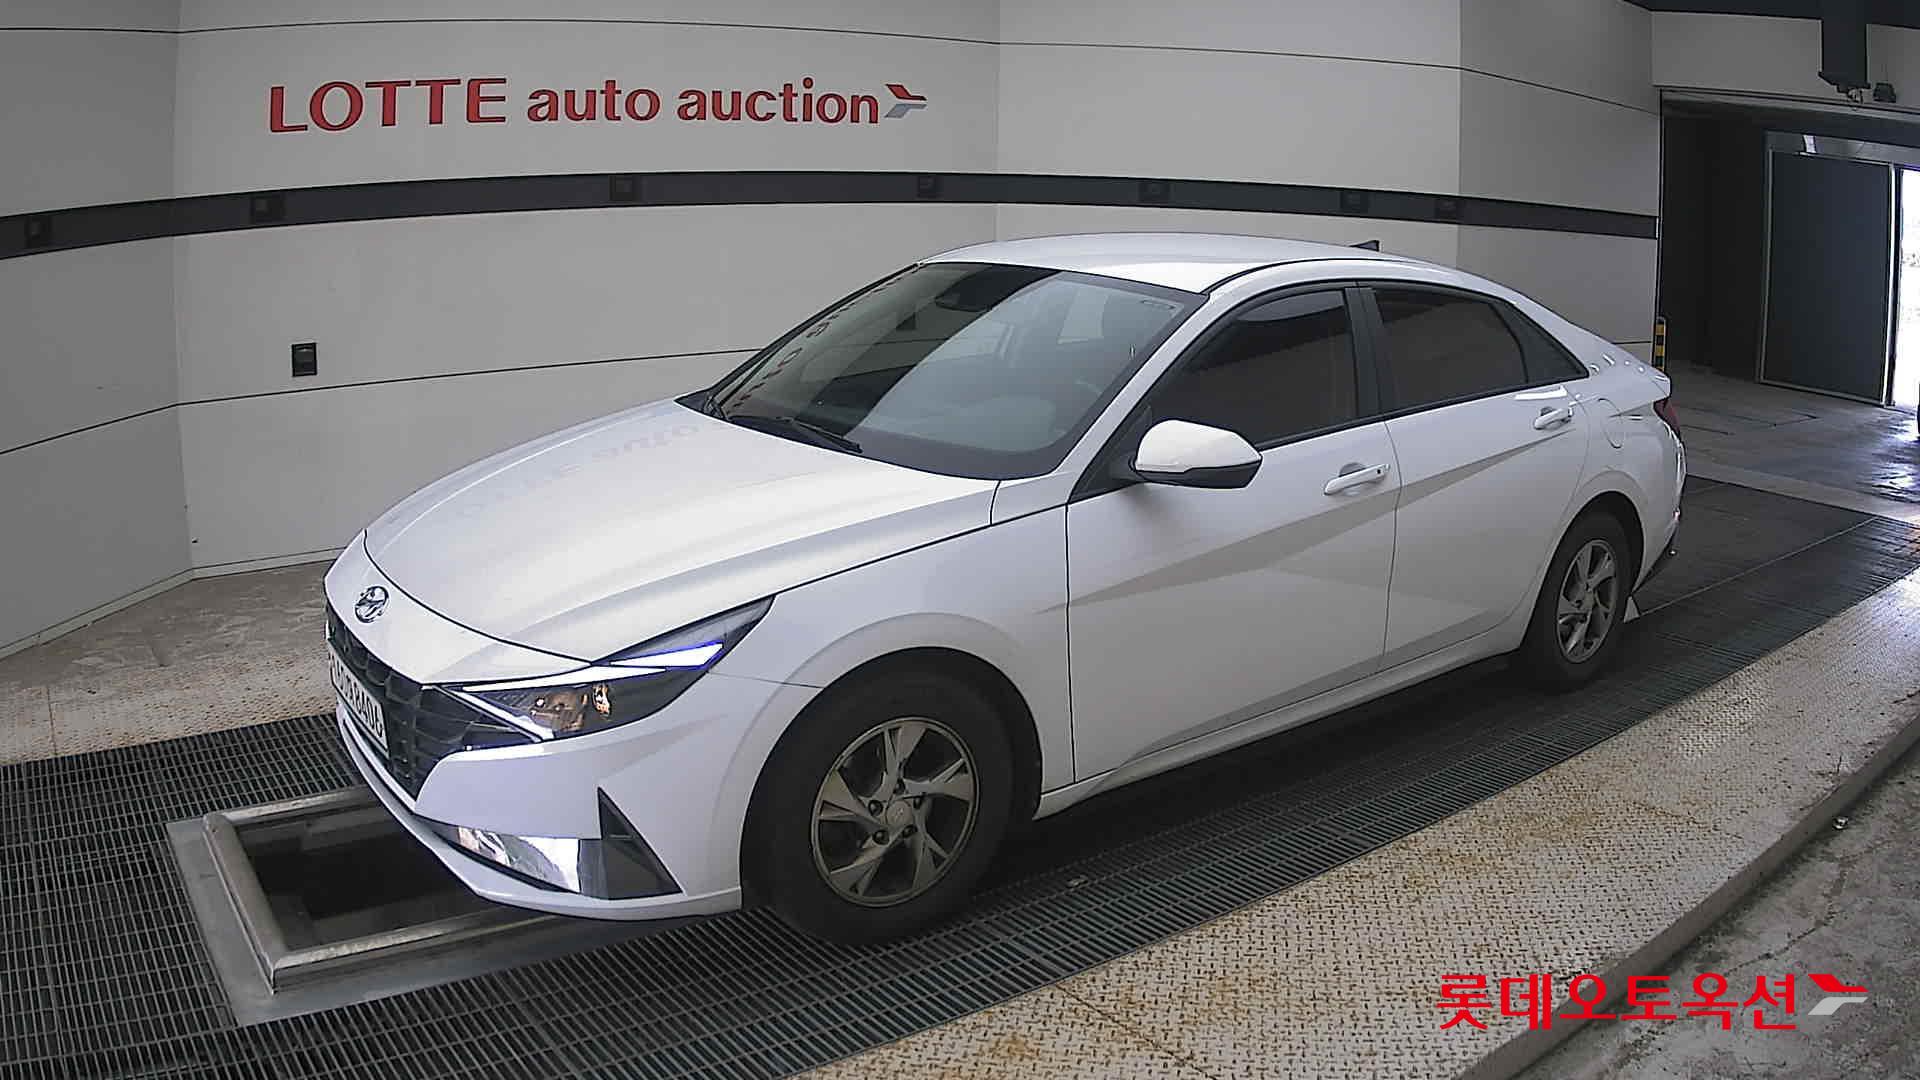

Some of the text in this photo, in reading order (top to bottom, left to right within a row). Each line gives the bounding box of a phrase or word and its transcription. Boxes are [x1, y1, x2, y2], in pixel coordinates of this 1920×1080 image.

[270, 77, 880, 133] LOTTE auto auction
